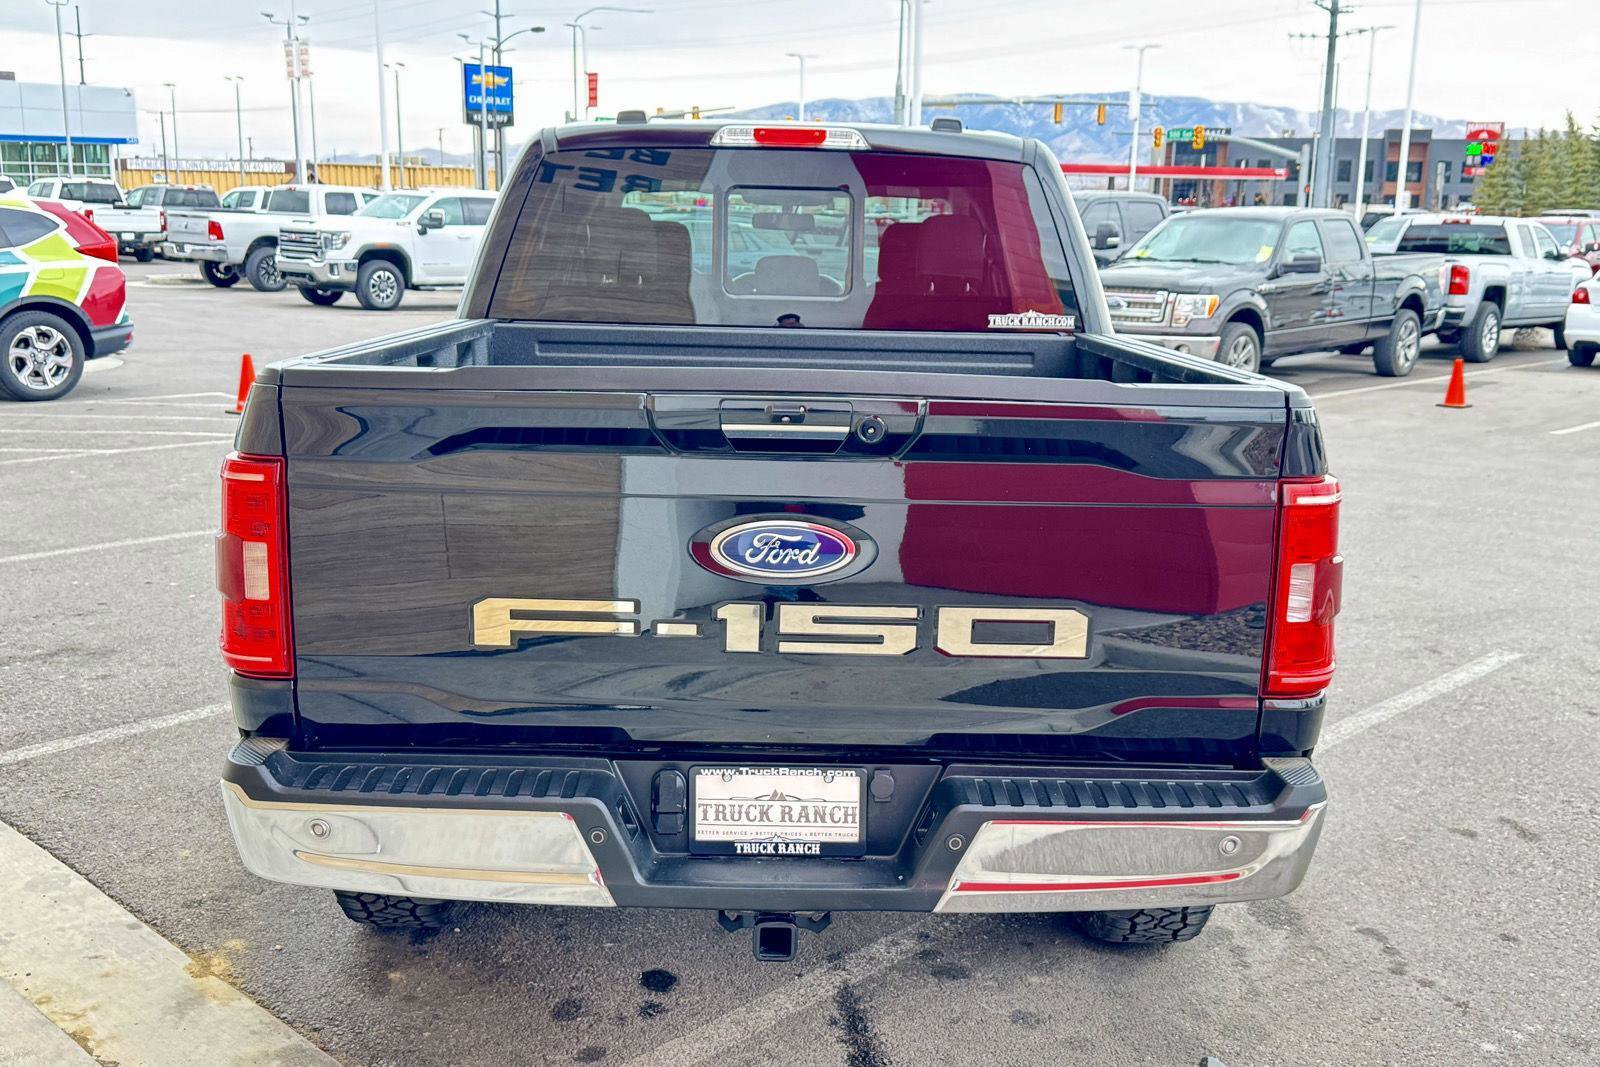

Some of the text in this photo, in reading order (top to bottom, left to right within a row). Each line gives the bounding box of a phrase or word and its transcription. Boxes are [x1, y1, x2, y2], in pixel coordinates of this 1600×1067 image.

[469, 95, 511, 106] CHVRLET
[988, 316, 1020, 327] TRUCK
[745, 532, 821, 565] Ford
[470, 598, 1091, 659] F-150
[700, 767, 856, 777] www.TruckRanch.com
[697, 803, 858, 824] TRUCK RANCH
[734, 842, 821, 854] TRUCK RANCH
